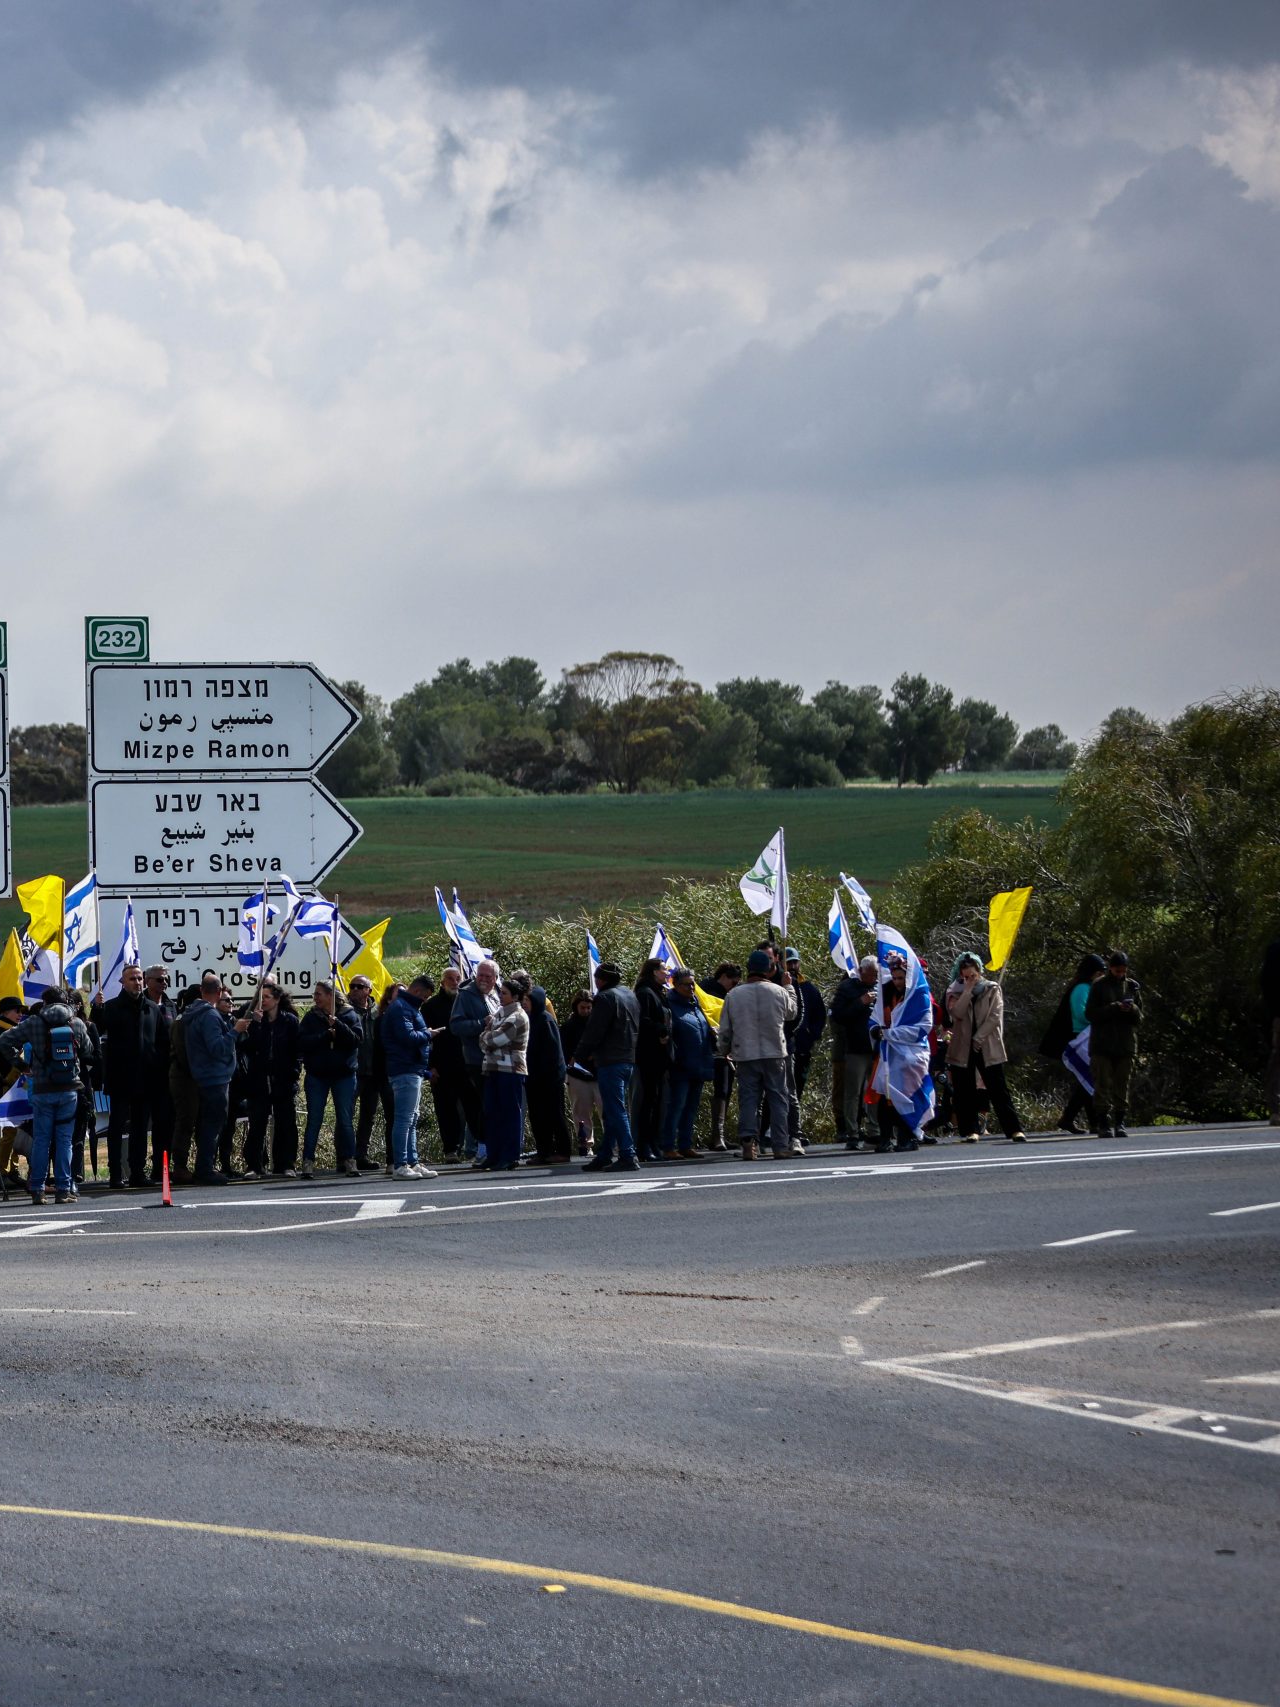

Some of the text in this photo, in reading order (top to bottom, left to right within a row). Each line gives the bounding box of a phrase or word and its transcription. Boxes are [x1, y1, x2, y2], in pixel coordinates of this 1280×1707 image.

[98, 630, 137, 648] 232
[144, 679, 269, 702] מצפה רמון
[139, 712, 197, 733] رمون
[124, 739, 289, 764] Mizpe Ramon
[155, 793, 261, 813] באר שבע
[209, 853, 282, 873] Sheva
[146, 908, 200, 927] רפיח
[160, 936, 201, 962] رفح
[201, 967, 312, 989] rosing
